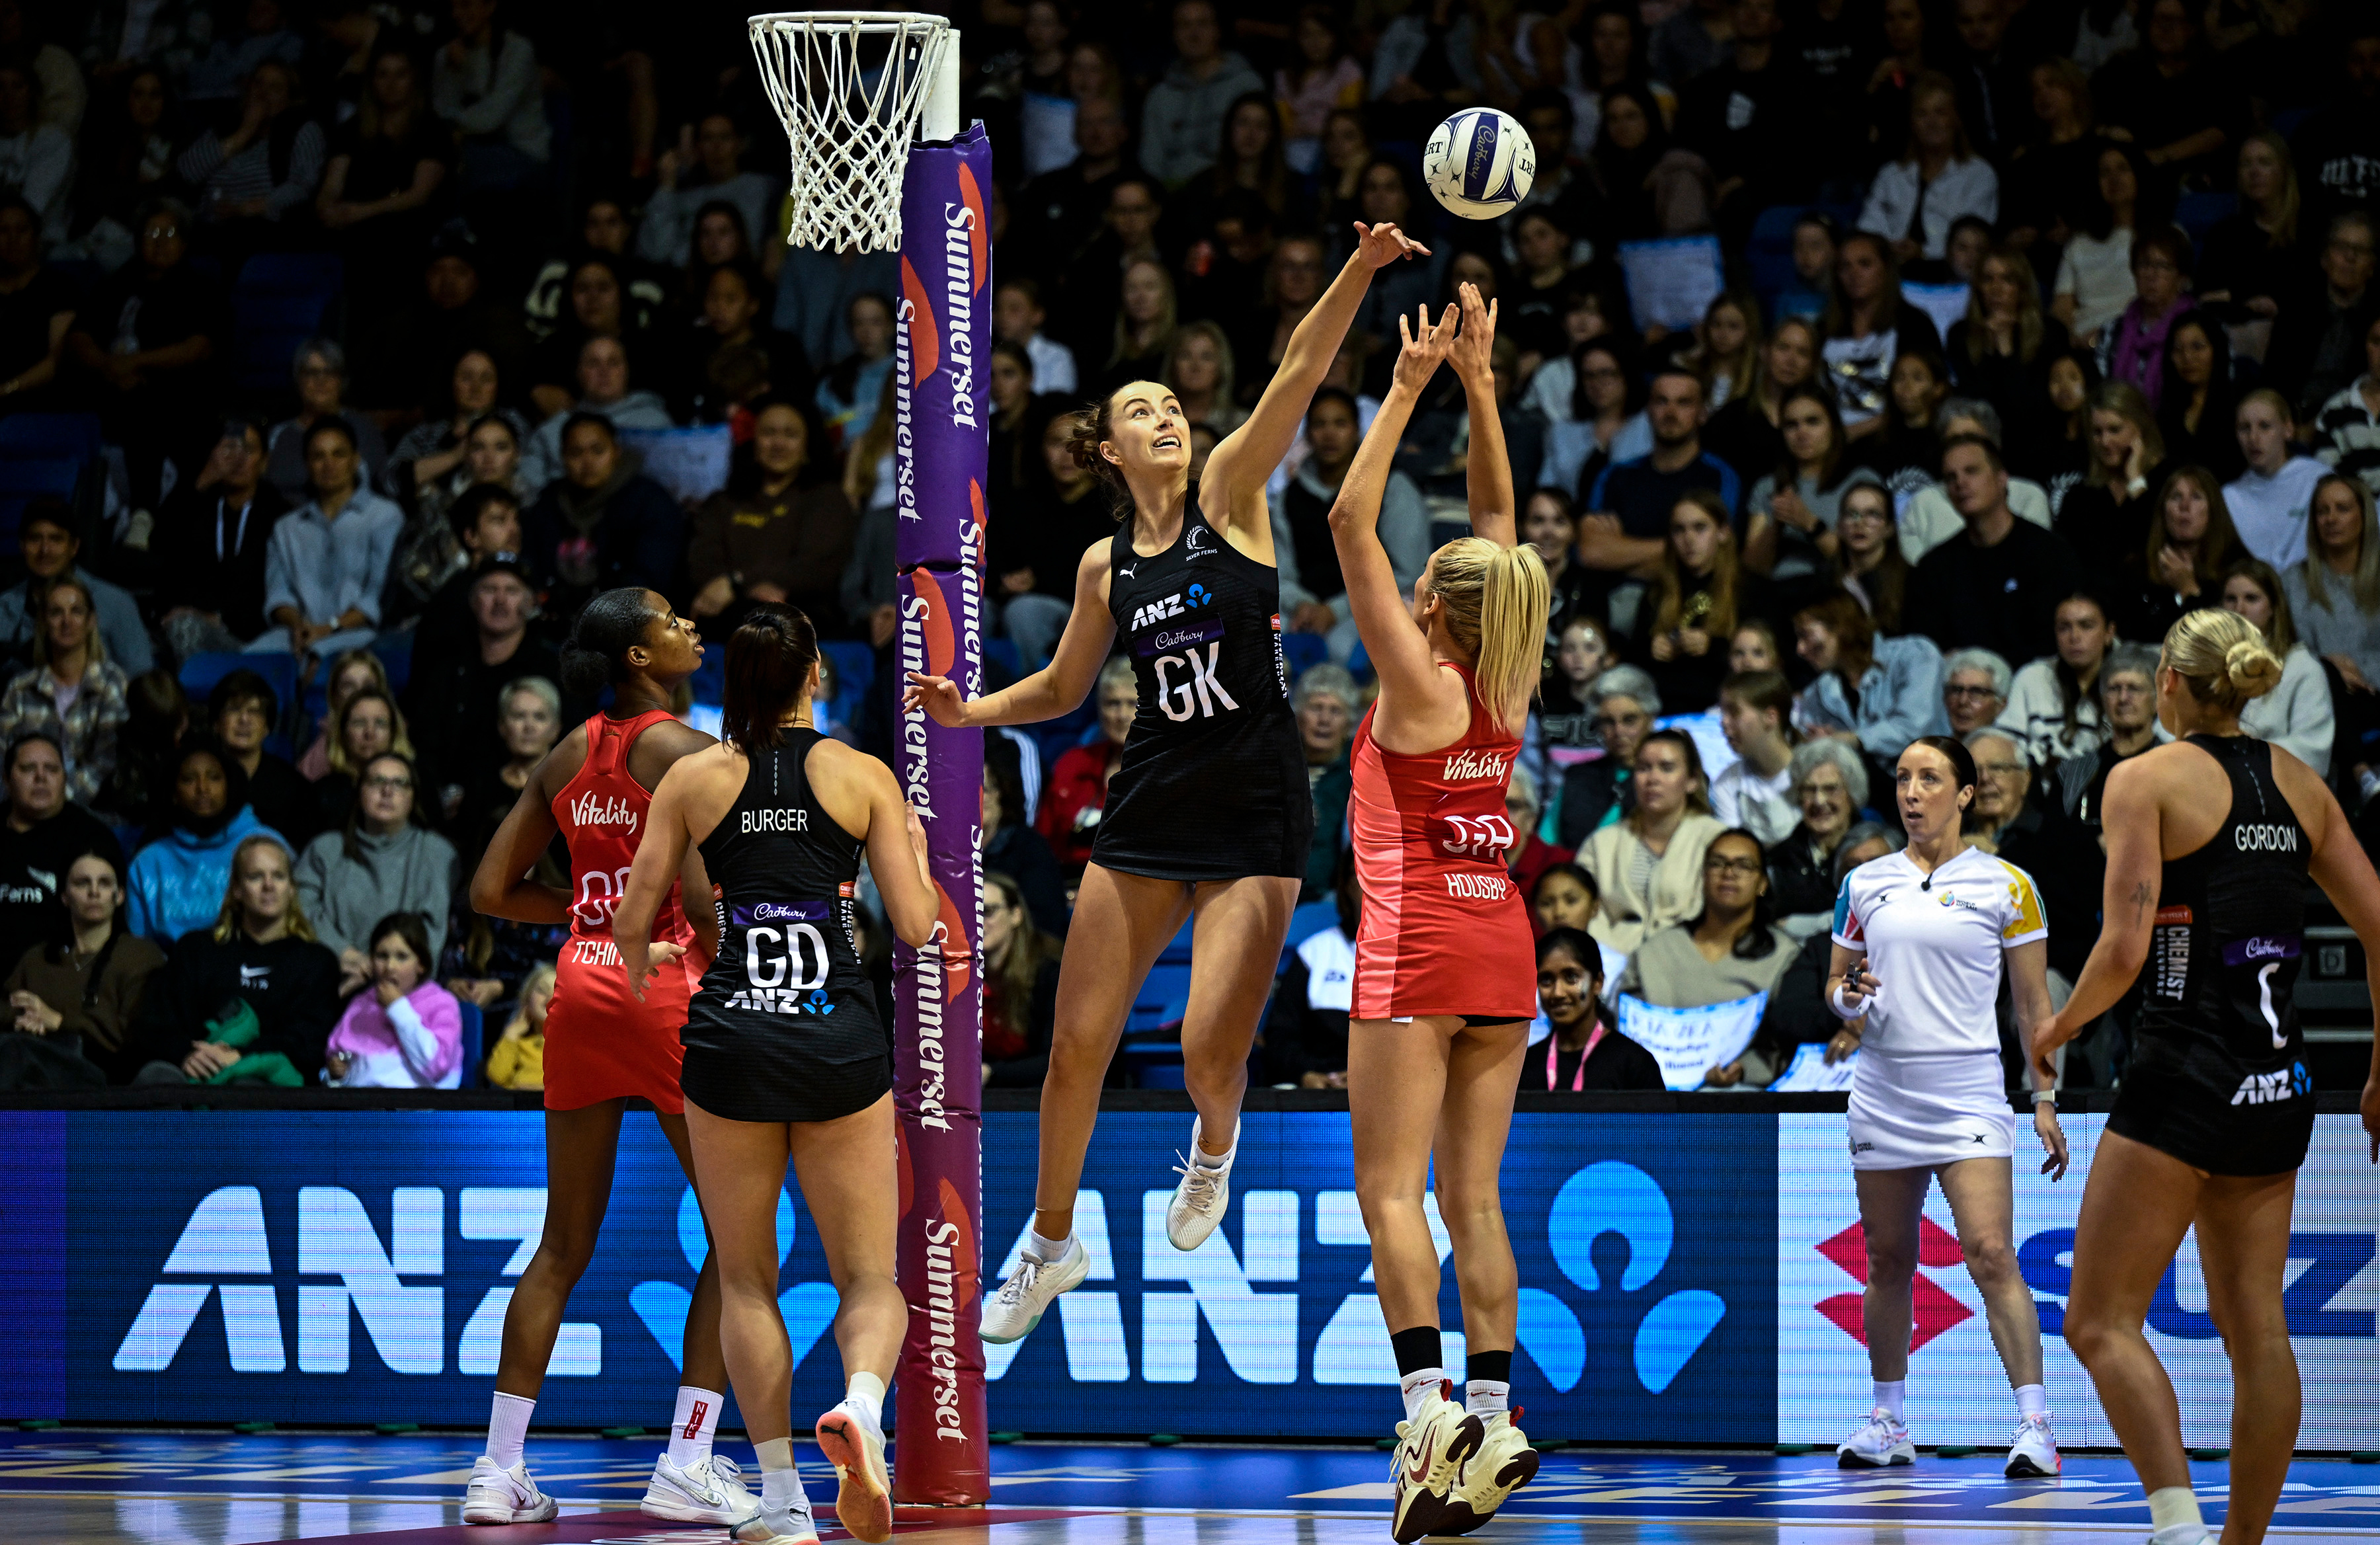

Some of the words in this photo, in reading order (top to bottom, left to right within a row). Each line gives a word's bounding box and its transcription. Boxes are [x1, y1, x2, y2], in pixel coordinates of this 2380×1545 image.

[1466, 126, 1495, 180] Cadbury
[945, 202, 978, 431] Summerset
[896, 297, 923, 524] Summerset
[1185, 551, 1201, 562] SILVER
[1201, 548, 1218, 557] FERNS
[1131, 593, 1185, 632] ANZ
[1156, 630, 1203, 650] Cadbury
[1154, 641, 1240, 722] GK
[1443, 748, 1507, 787] Vitality
[571, 790, 637, 836] Vitality
[741, 809, 809, 834] BURGER
[2235, 823, 2297, 852] GORDON
[1443, 873, 1506, 900] HOUSBY
[753, 902, 807, 921] Cadbury
[746, 922, 830, 990] GD
[2165, 926, 2190, 1002] CHEMIST
[724, 988, 800, 1015] ANZ
[2230, 1068, 2293, 1107] ANZ
[113, 1185, 602, 1376] ANZ
[983, 1189, 1466, 1385] ANZ
[926, 1218, 969, 1443] Summerset
[686, 1402, 705, 1438] NIKE
